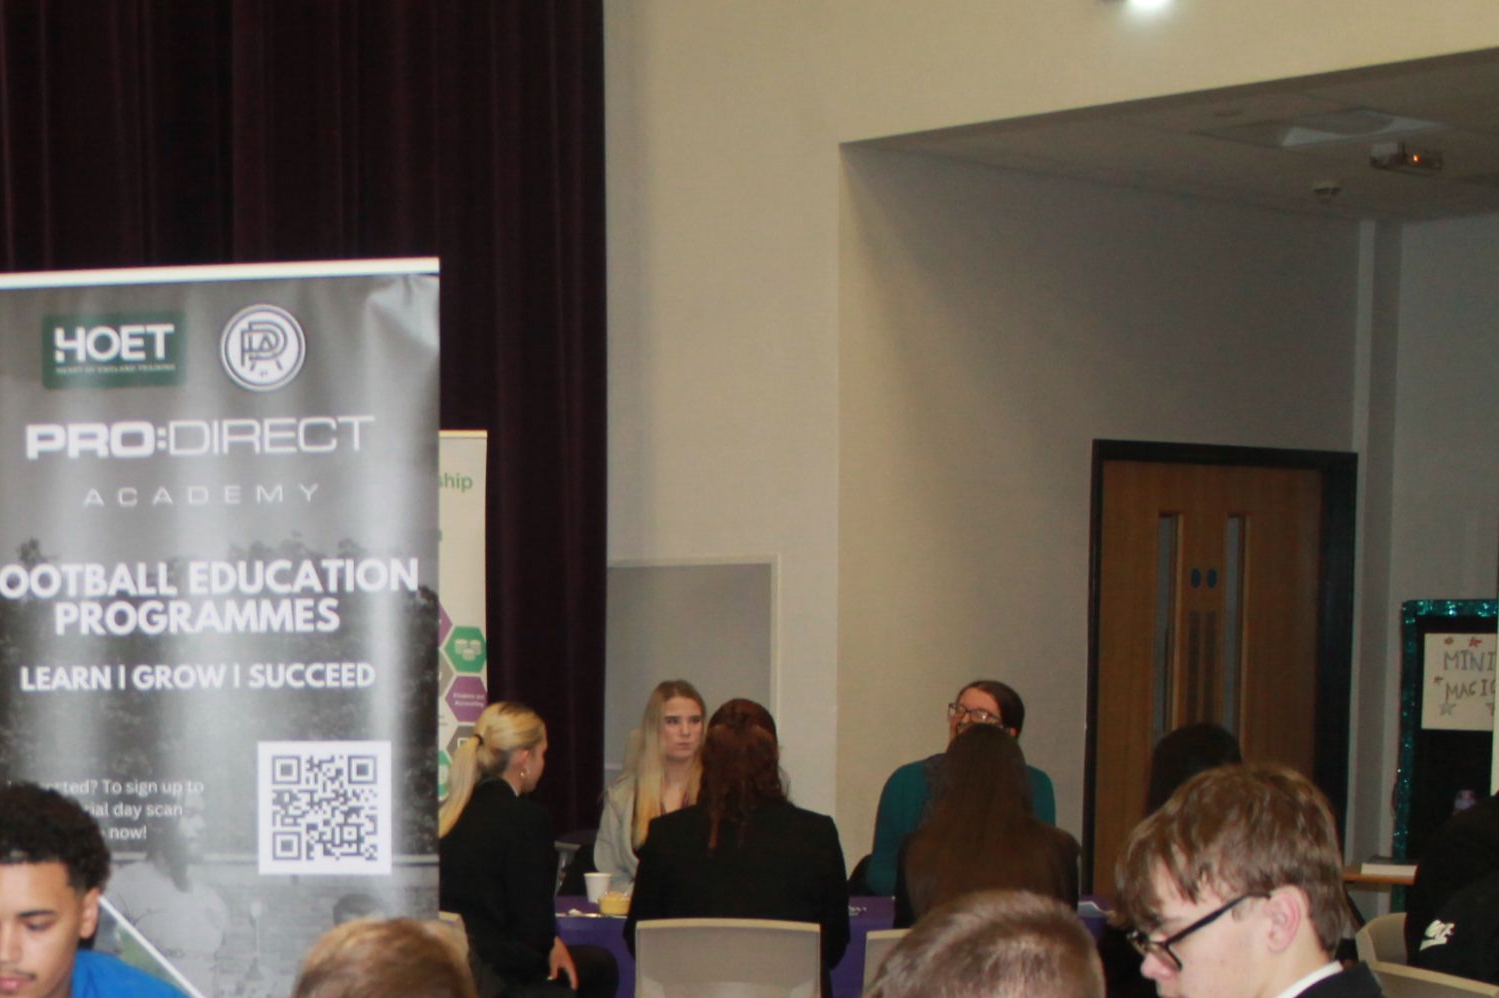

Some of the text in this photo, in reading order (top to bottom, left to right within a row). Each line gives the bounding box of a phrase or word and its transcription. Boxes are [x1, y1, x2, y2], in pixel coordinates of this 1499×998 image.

[55, 324, 174, 363] HOET
[26, 415, 376, 460] PRO:DIRECT
[83, 483, 319, 507] ACADEMY
[189, 558, 419, 594] EDUCATION
[54, 598, 340, 635] PROGRAMMES
[20, 666, 112, 691] LEARN
[132, 664, 228, 690] GROW
[248, 662, 376, 688] SUCCEED
[100, 779, 122, 794] To
[125, 778, 158, 798] sign
[162, 780, 185, 798] up
[186, 779, 204, 794] to
[113, 802, 142, 821] day
[146, 804, 183, 817] scan
[109, 824, 147, 840] now!
